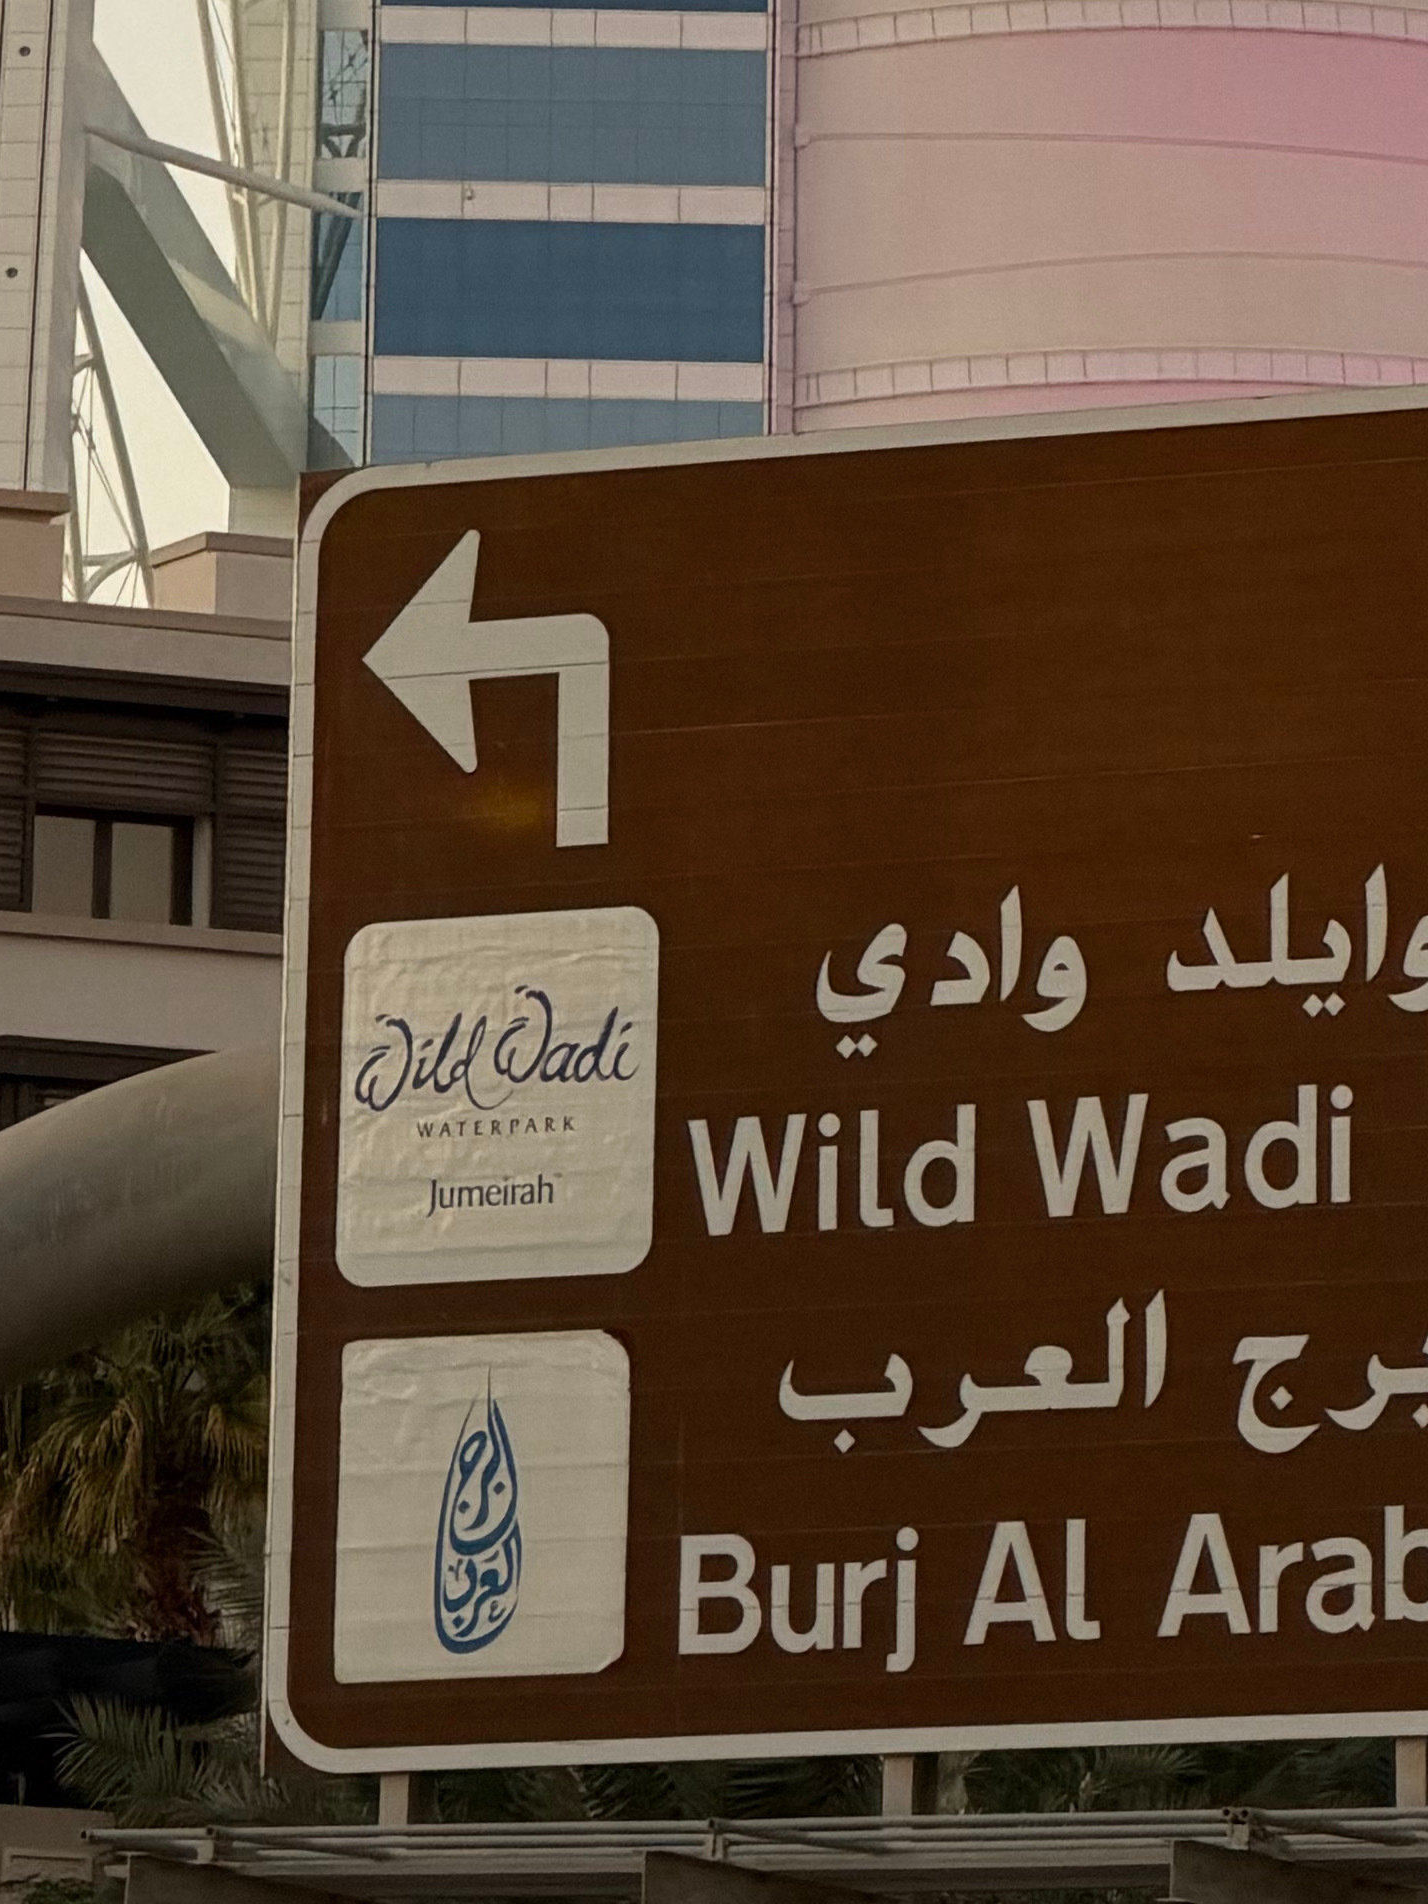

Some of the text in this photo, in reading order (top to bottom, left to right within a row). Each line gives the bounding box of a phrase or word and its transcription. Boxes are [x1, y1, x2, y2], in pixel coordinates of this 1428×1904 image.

[354, 984, 640, 1111] Wild Wadi
[816, 885, 1087, 1059] وادي
[416, 1115, 576, 1139] WATERPARK
[426, 1173, 555, 1218] Jumeirah
[688, 1083, 1354, 1237] Wild Wadi
[778, 1289, 1167, 1453] العرب
[678, 1526, 919, 1673] Burj
[963, 1518, 1101, 1645] Al
